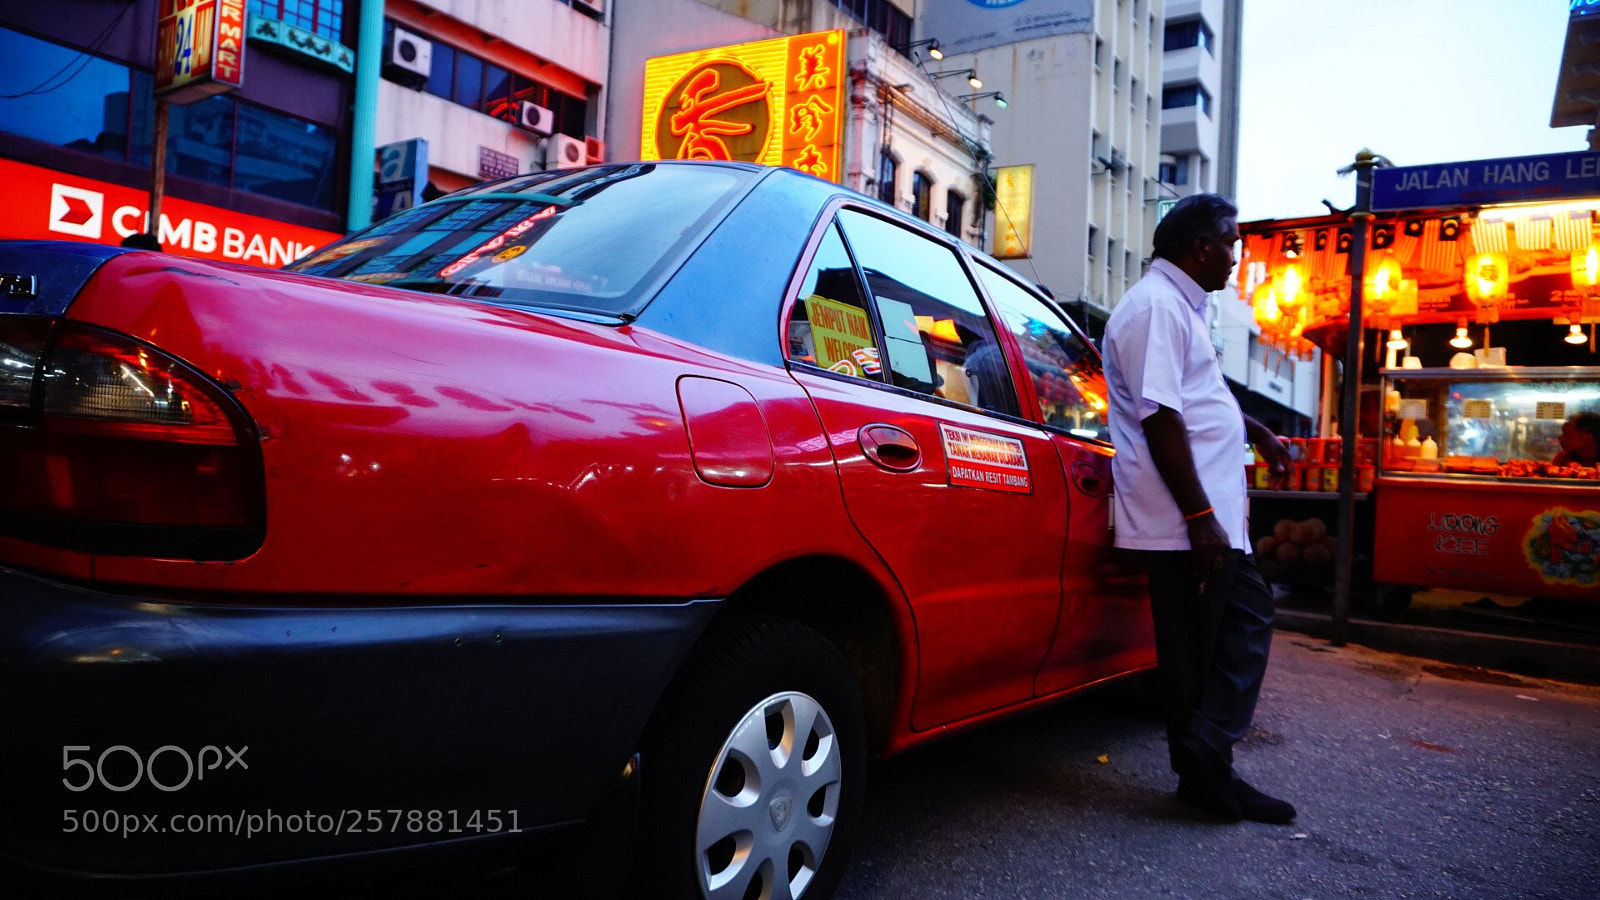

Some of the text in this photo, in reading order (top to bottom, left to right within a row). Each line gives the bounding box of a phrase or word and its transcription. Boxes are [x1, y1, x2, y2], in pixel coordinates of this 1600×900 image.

[175, 14, 192, 76] 24
[1395, 167, 1469, 191] JALAN
[1483, 161, 1550, 184] HANG
[112, 205, 217, 253] CIMB
[811, 302, 847, 334] JEMPUT
[823, 336, 865, 368] WELCO
[944, 428, 962, 441] TEKSI
[952, 466, 1028, 487] DAPATKAN RESIT TAMBANG
